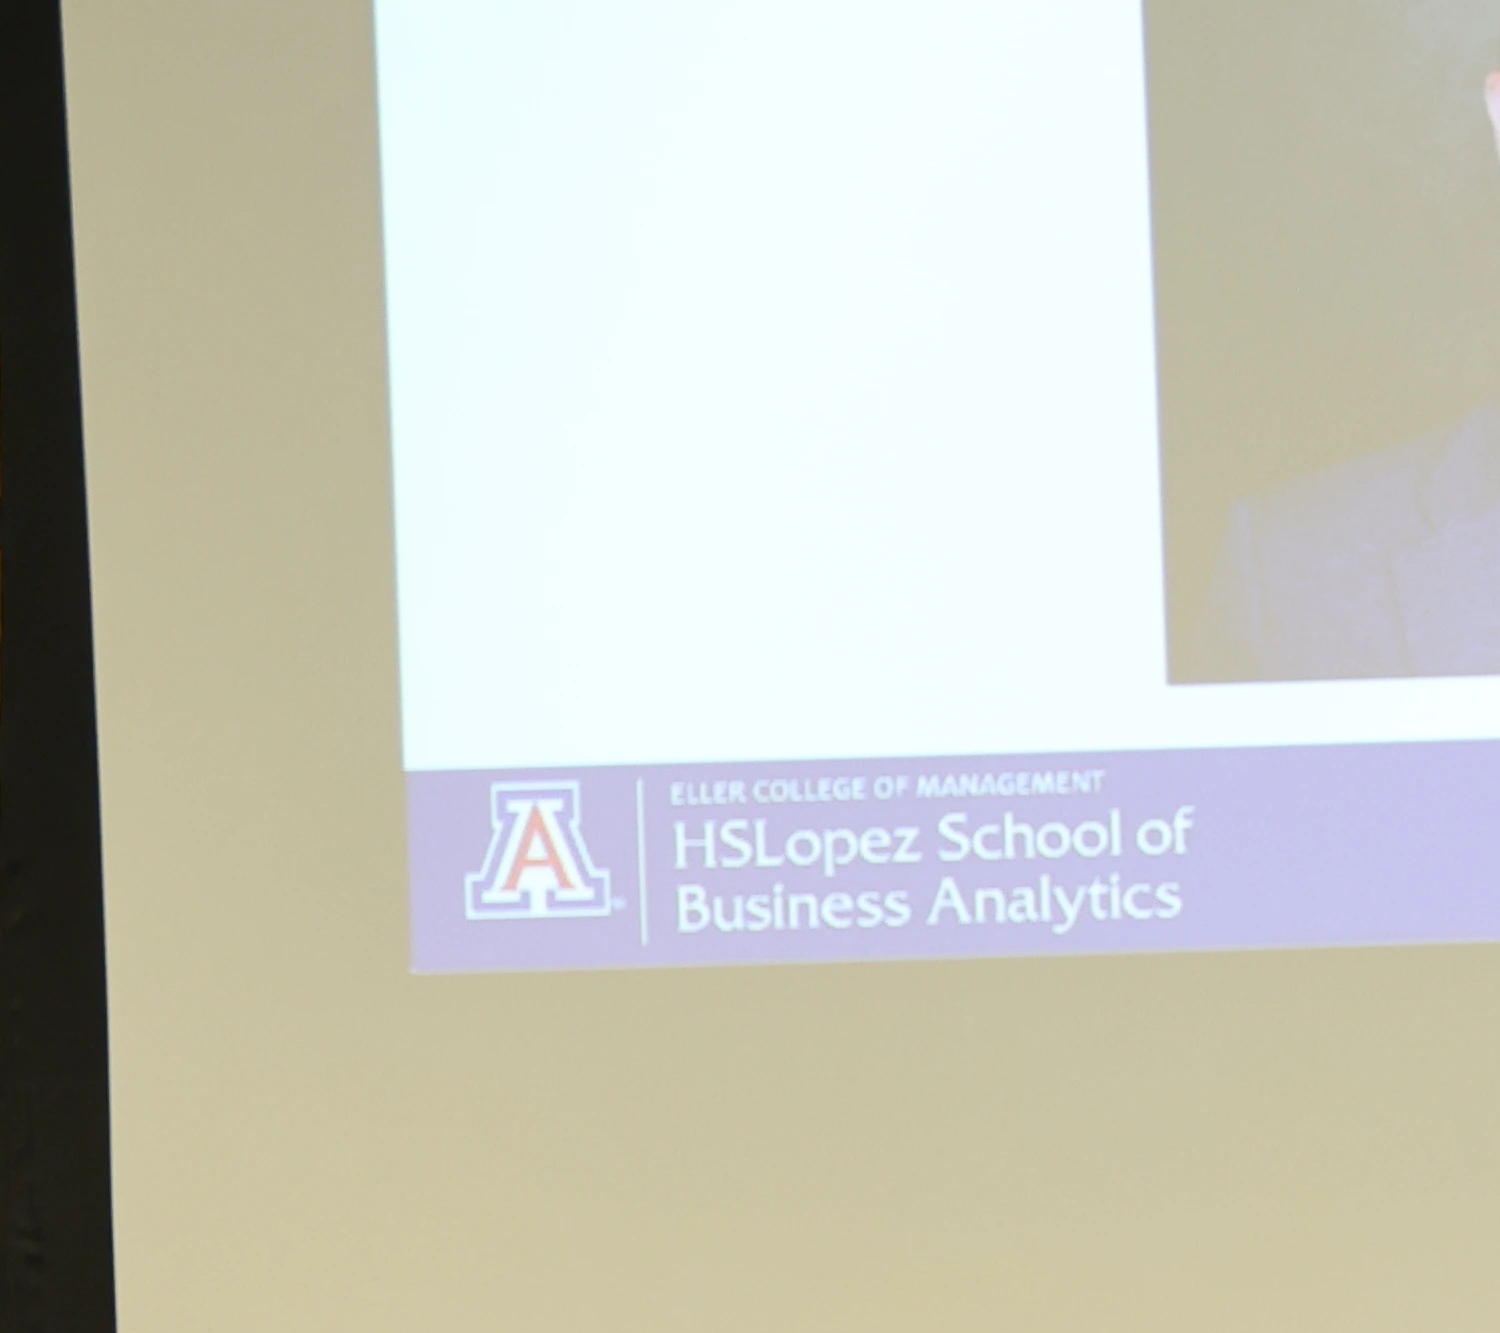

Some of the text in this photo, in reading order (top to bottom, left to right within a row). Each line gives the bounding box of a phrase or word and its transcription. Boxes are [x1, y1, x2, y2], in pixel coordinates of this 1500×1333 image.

[669, 769, 1107, 806] ELLER COLLEGE OF MANAGEMENT
[672, 804, 1195, 878] HSLopez School of
[676, 871, 1184, 936] Business Analytics
